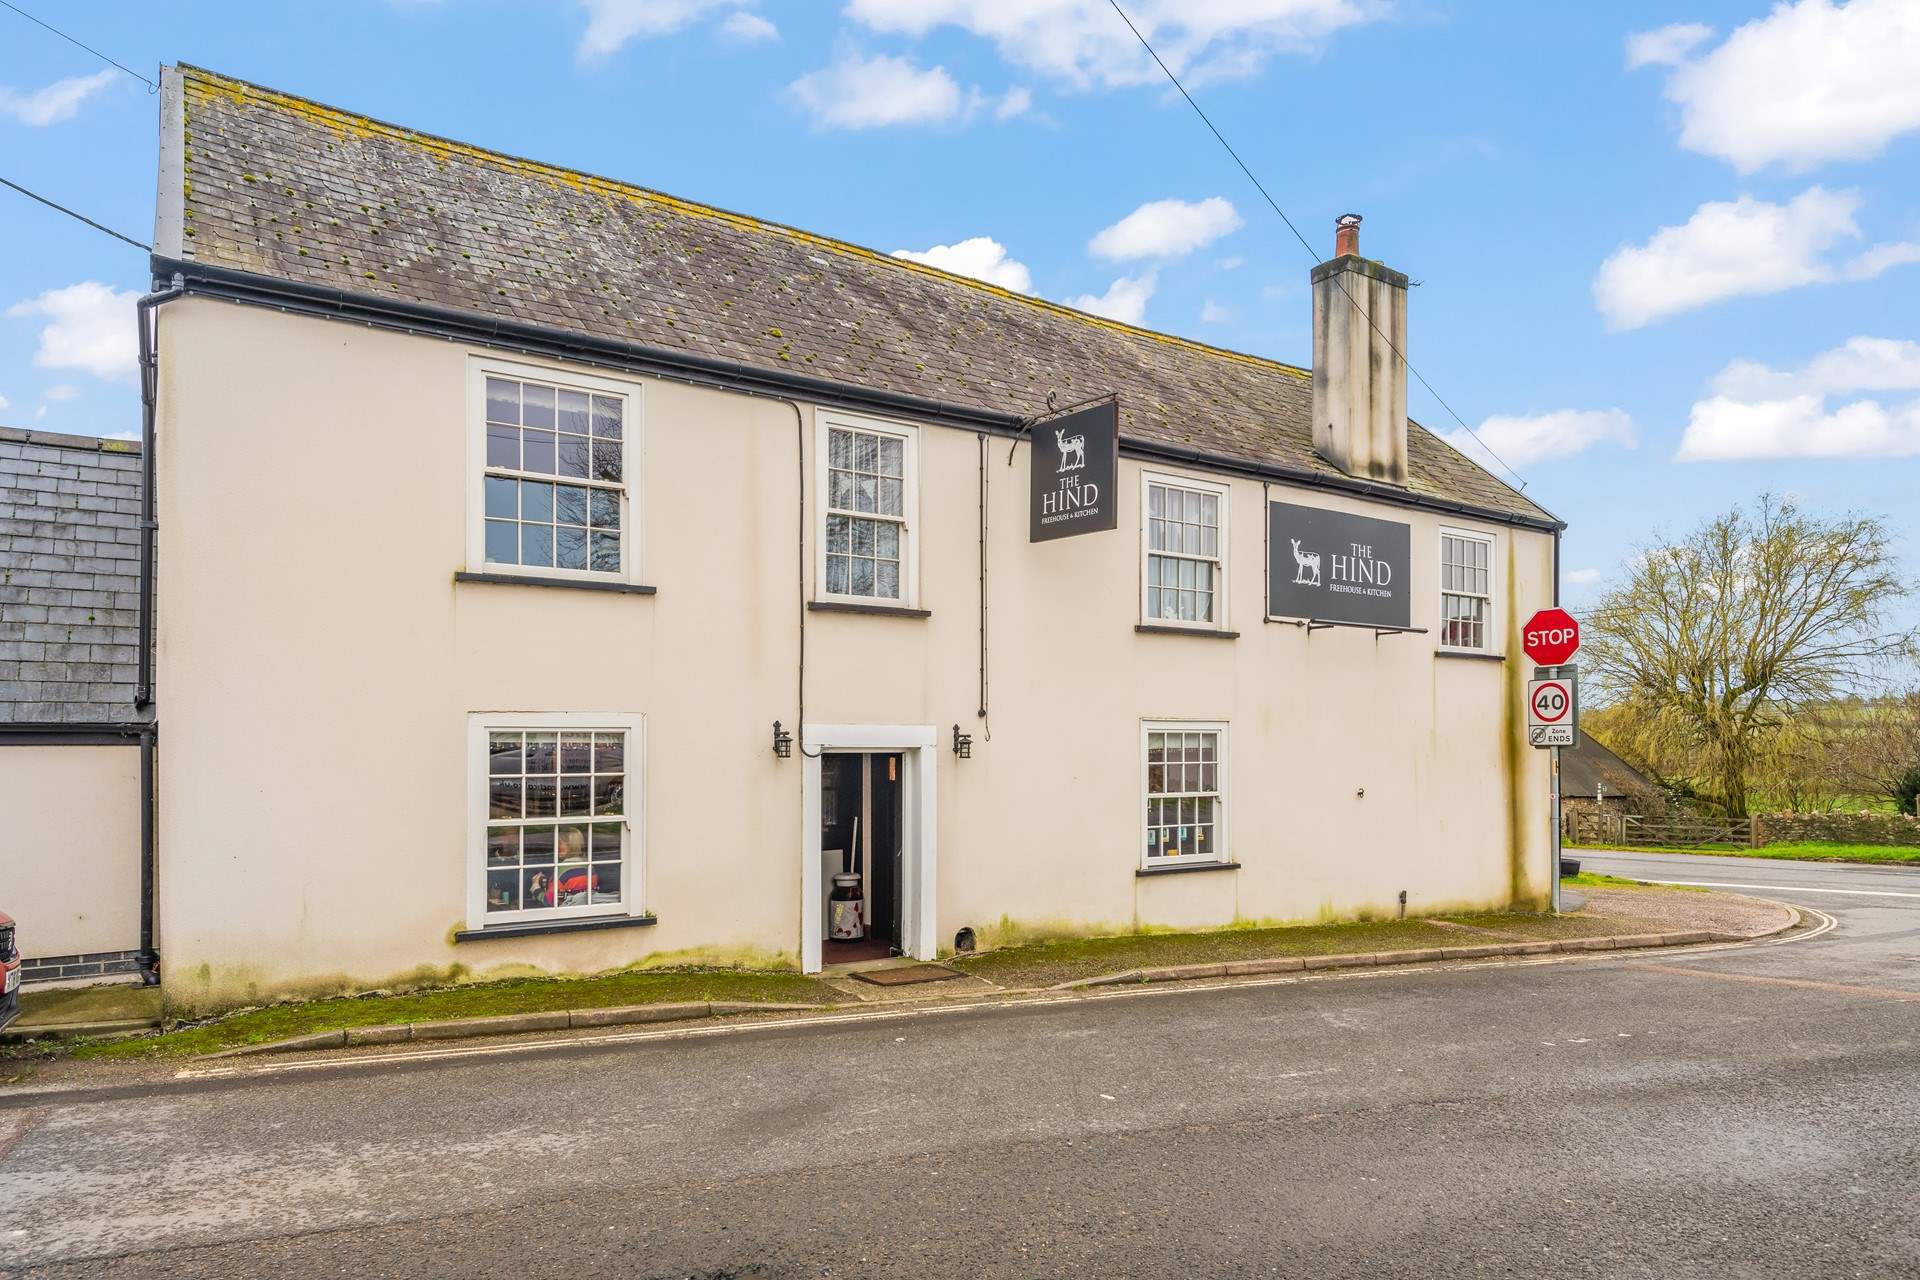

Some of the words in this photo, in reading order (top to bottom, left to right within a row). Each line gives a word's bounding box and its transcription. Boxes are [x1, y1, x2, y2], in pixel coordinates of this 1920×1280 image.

[1059, 475, 1080, 489] THE
[1043, 484, 1098, 515] HIND
[1042, 513, 1070, 525] FREEHOUSE
[1074, 507, 1098, 518] KITCHEN
[1350, 543, 1372, 559] THE
[1331, 554, 1391, 586] HIND
[1330, 584, 1362, 595] FREEHOUSE
[1367, 588, 1392, 598] KITCHEN
[1527, 628, 1575, 647] STOP
[1537, 694, 1564, 711] 40
